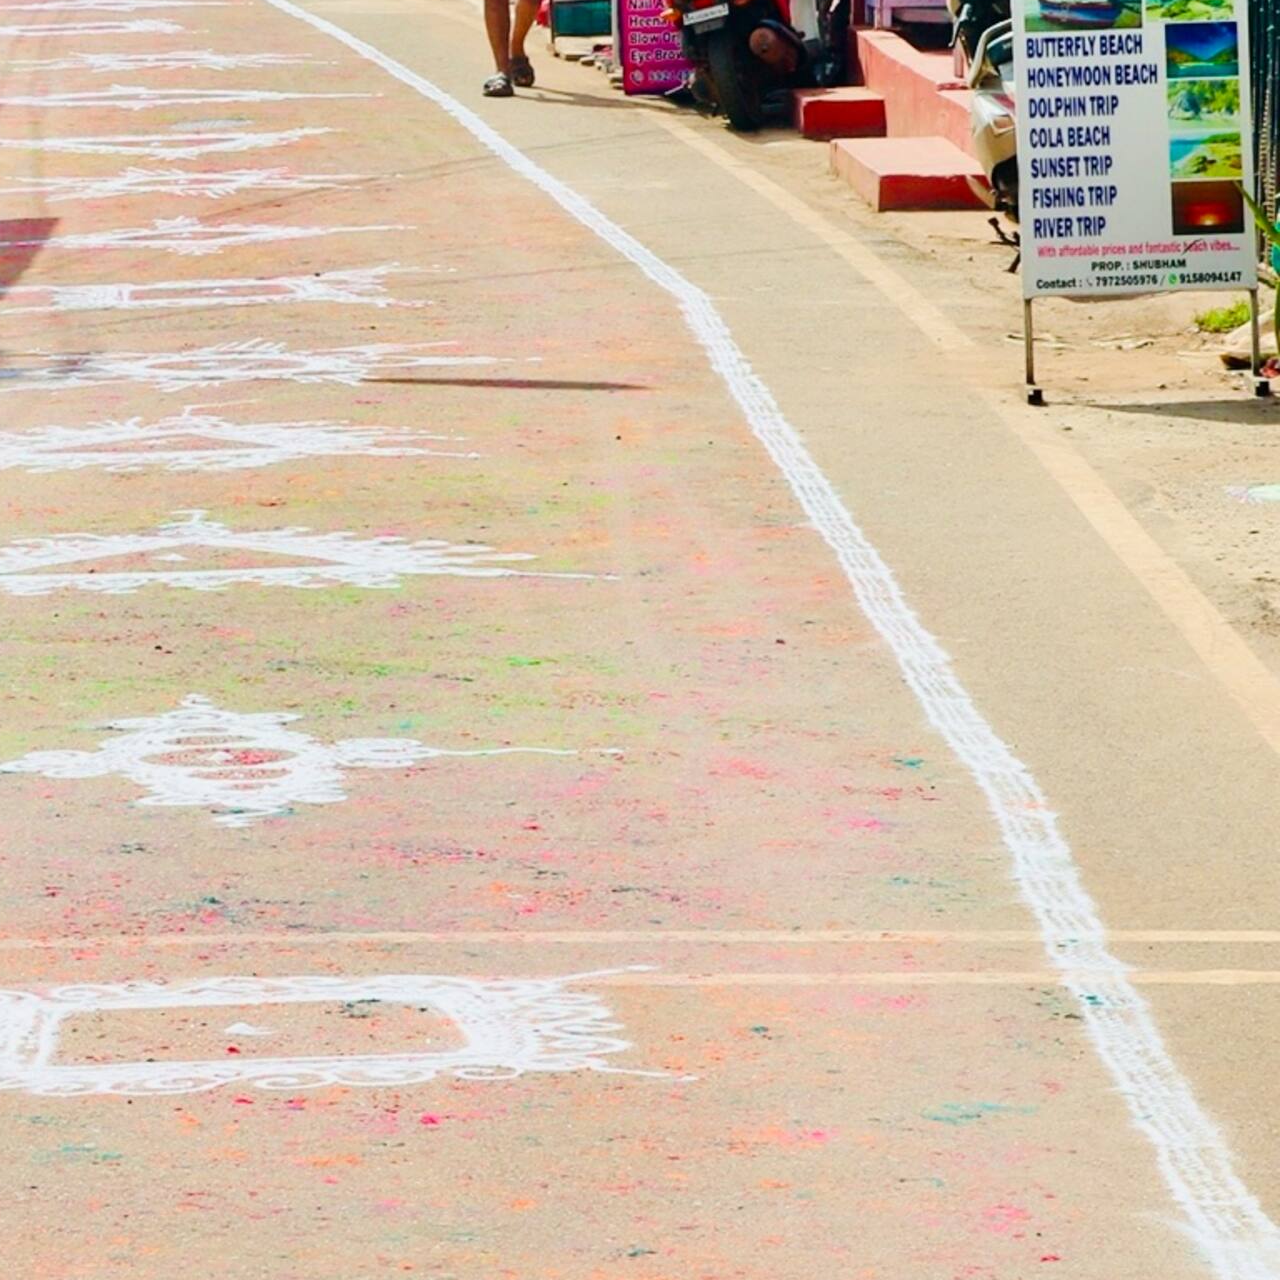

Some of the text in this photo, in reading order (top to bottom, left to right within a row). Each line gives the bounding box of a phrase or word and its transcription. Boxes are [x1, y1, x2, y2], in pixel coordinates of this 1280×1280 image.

[1026, 33, 1143, 58] BUTTERFLY BEACH
[1027, 64, 1158, 88] HONEYMOON BEACH
[1029, 95, 1119, 118] DOLPHIN TRIP
[1029, 125, 1111, 148] COLA BEACH
[1031, 155, 1113, 179] SUNSET TRIP
[1032, 185, 1118, 209] FISHING TRIP
[1033, 216, 1106, 239] RIVER TRIP
[1038, 246, 1056, 257] With
[1058, 245, 1100, 256] affordable
[1102, 245, 1126, 256] prices
[1129, 244, 1143, 254] and
[1145, 242, 1181, 254] fantastic
[1132, 259, 1187, 270] SHUBHAM
[1036, 279, 1076, 289] Contact
[1096, 275, 1158, 287] 7972505976
[1179, 271, 1242, 284] 9158094147
